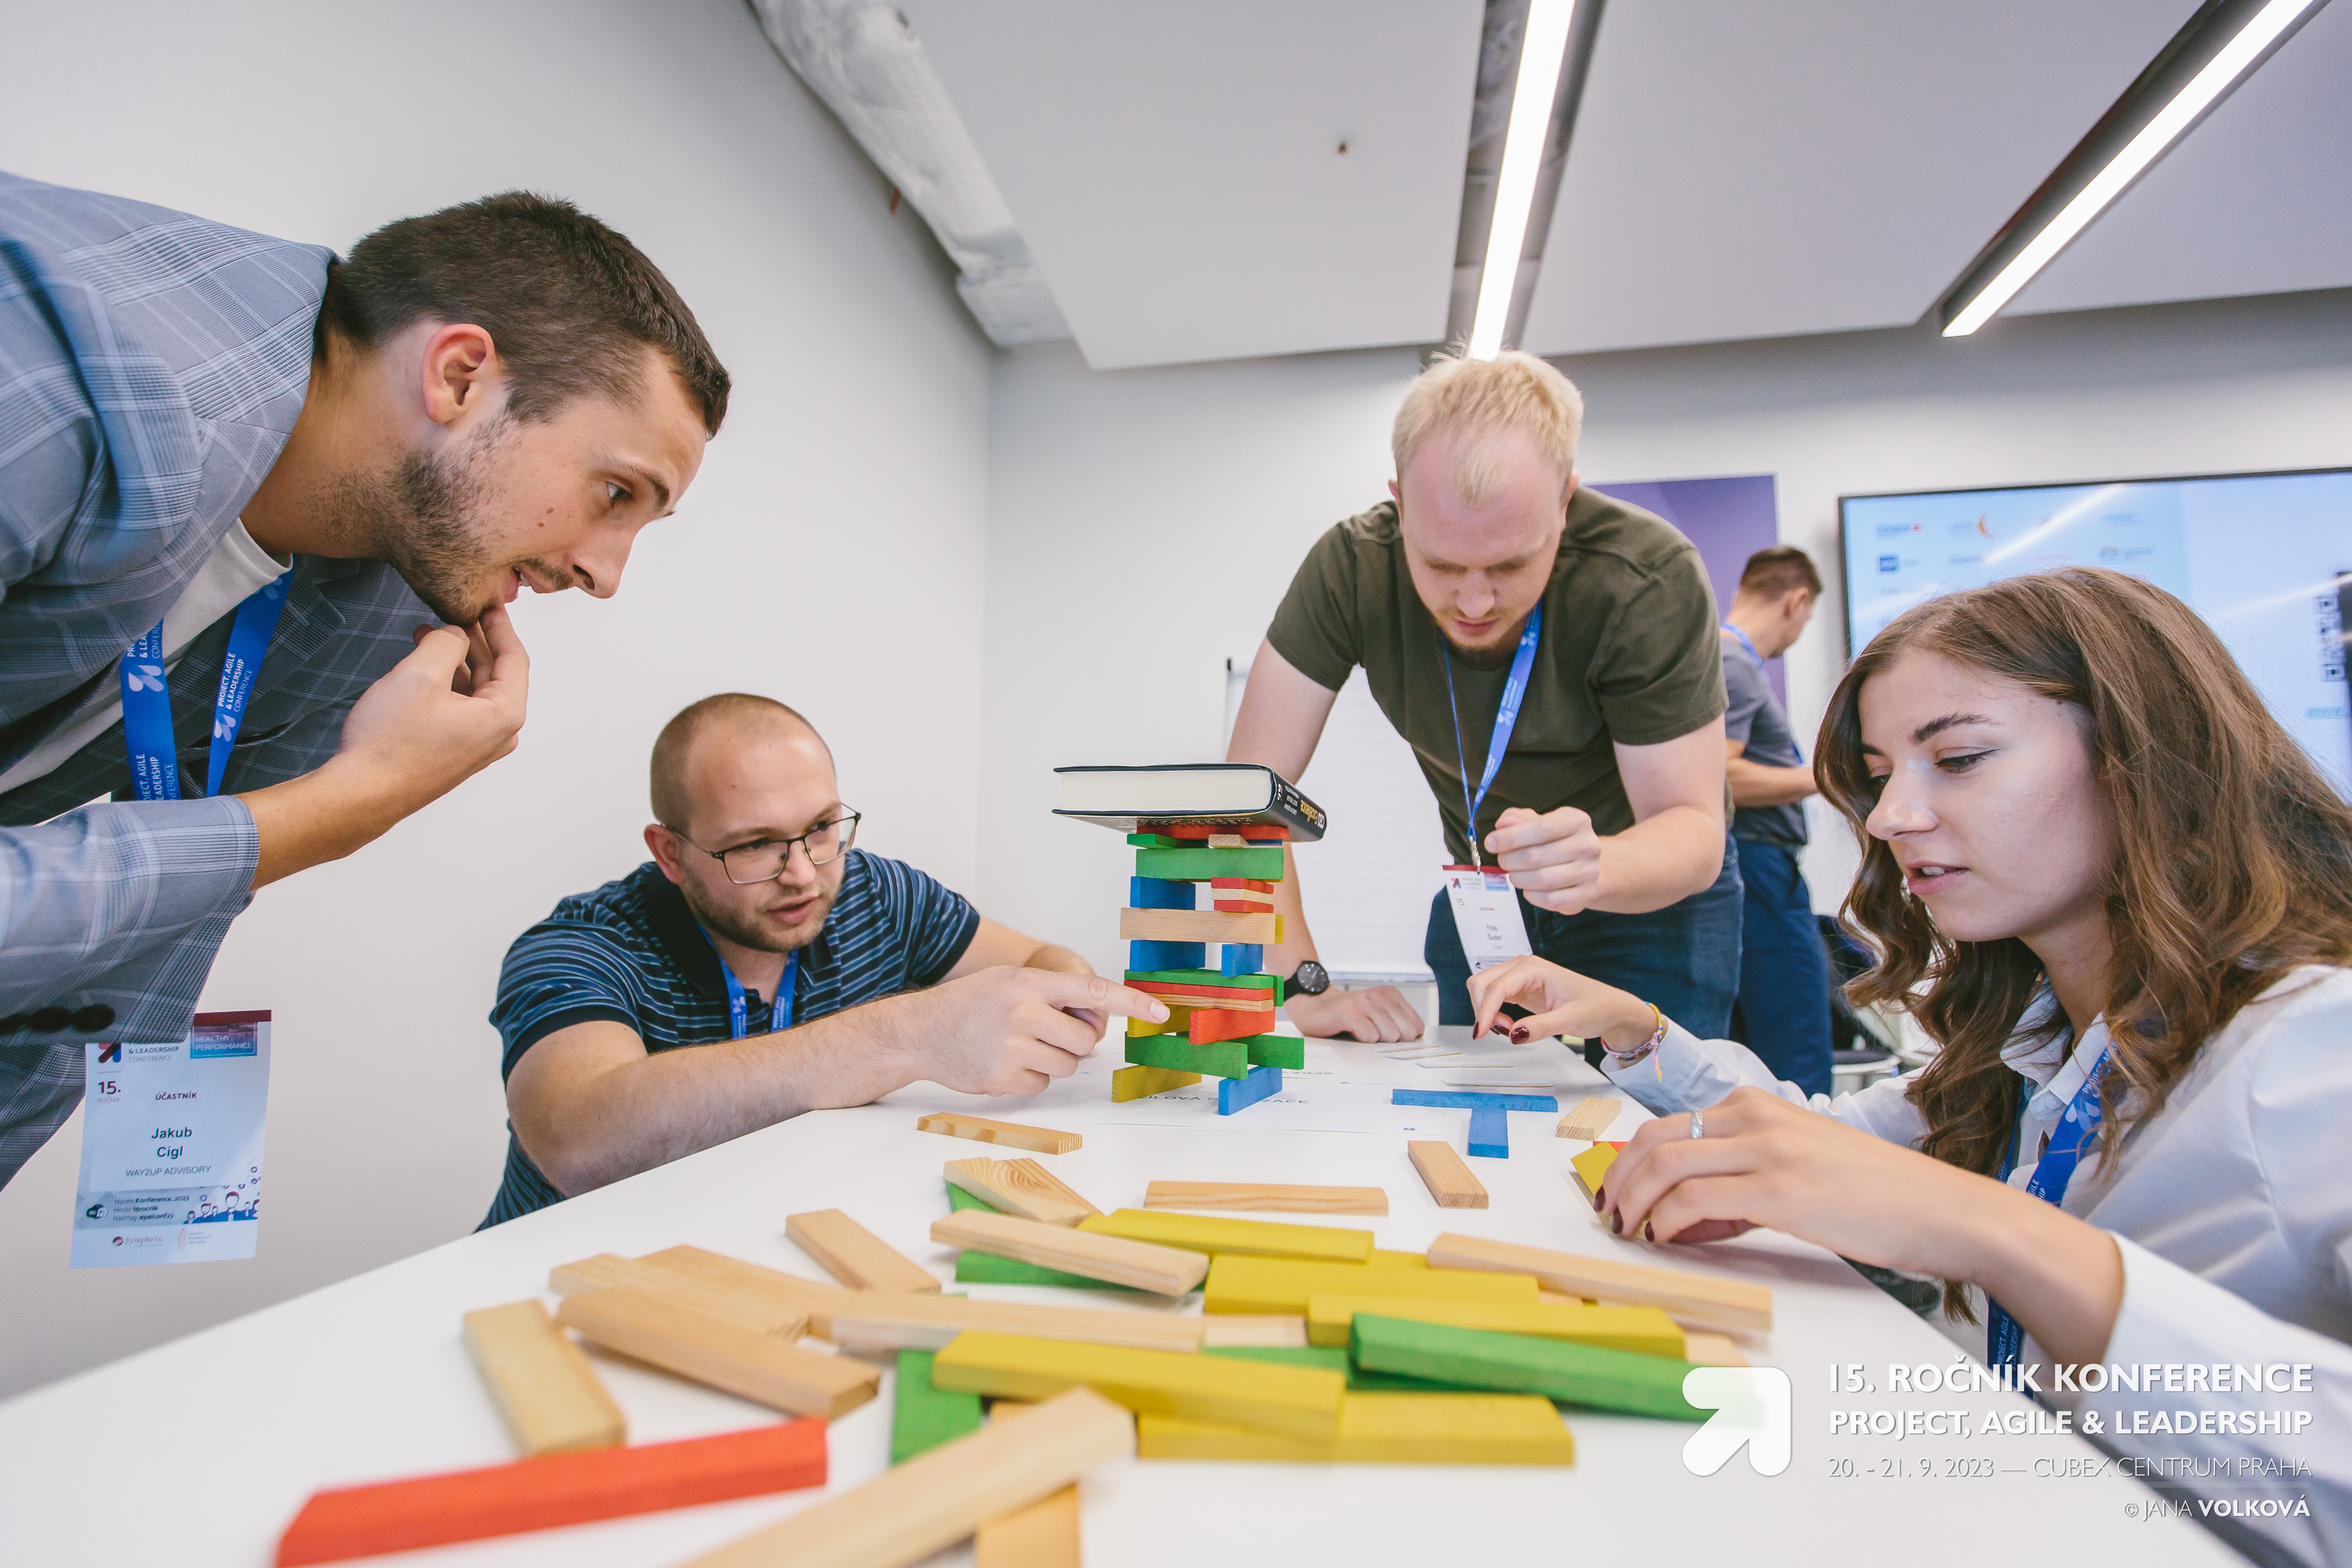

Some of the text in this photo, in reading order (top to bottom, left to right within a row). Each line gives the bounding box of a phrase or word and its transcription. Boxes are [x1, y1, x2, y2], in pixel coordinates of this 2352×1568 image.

[218, 652, 236, 707] PROJECT, AGILE
[227, 659, 245, 703] LEADERSHIP
[234, 669, 253, 712] CONFERENCE
[136, 754, 147, 776] AGILE
[1300, 799, 1318, 825] Excellence
[136, 1045, 180, 1054] LEADERSHIP
[196, 1042, 252, 1051] PERFORMANCE
[128, 1055, 172, 1063] CONFERENCE
[98, 1080, 122, 1095] 15.
[155, 1090, 198, 1101] ÚČASTNÍK
[152, 1126, 193, 1139] Jakub
[126, 1165, 212, 1177] WAY2UP ADVISORY
[125, 1235, 163, 1245] Symphera
[2000, 1315, 2009, 1336] AGILE
